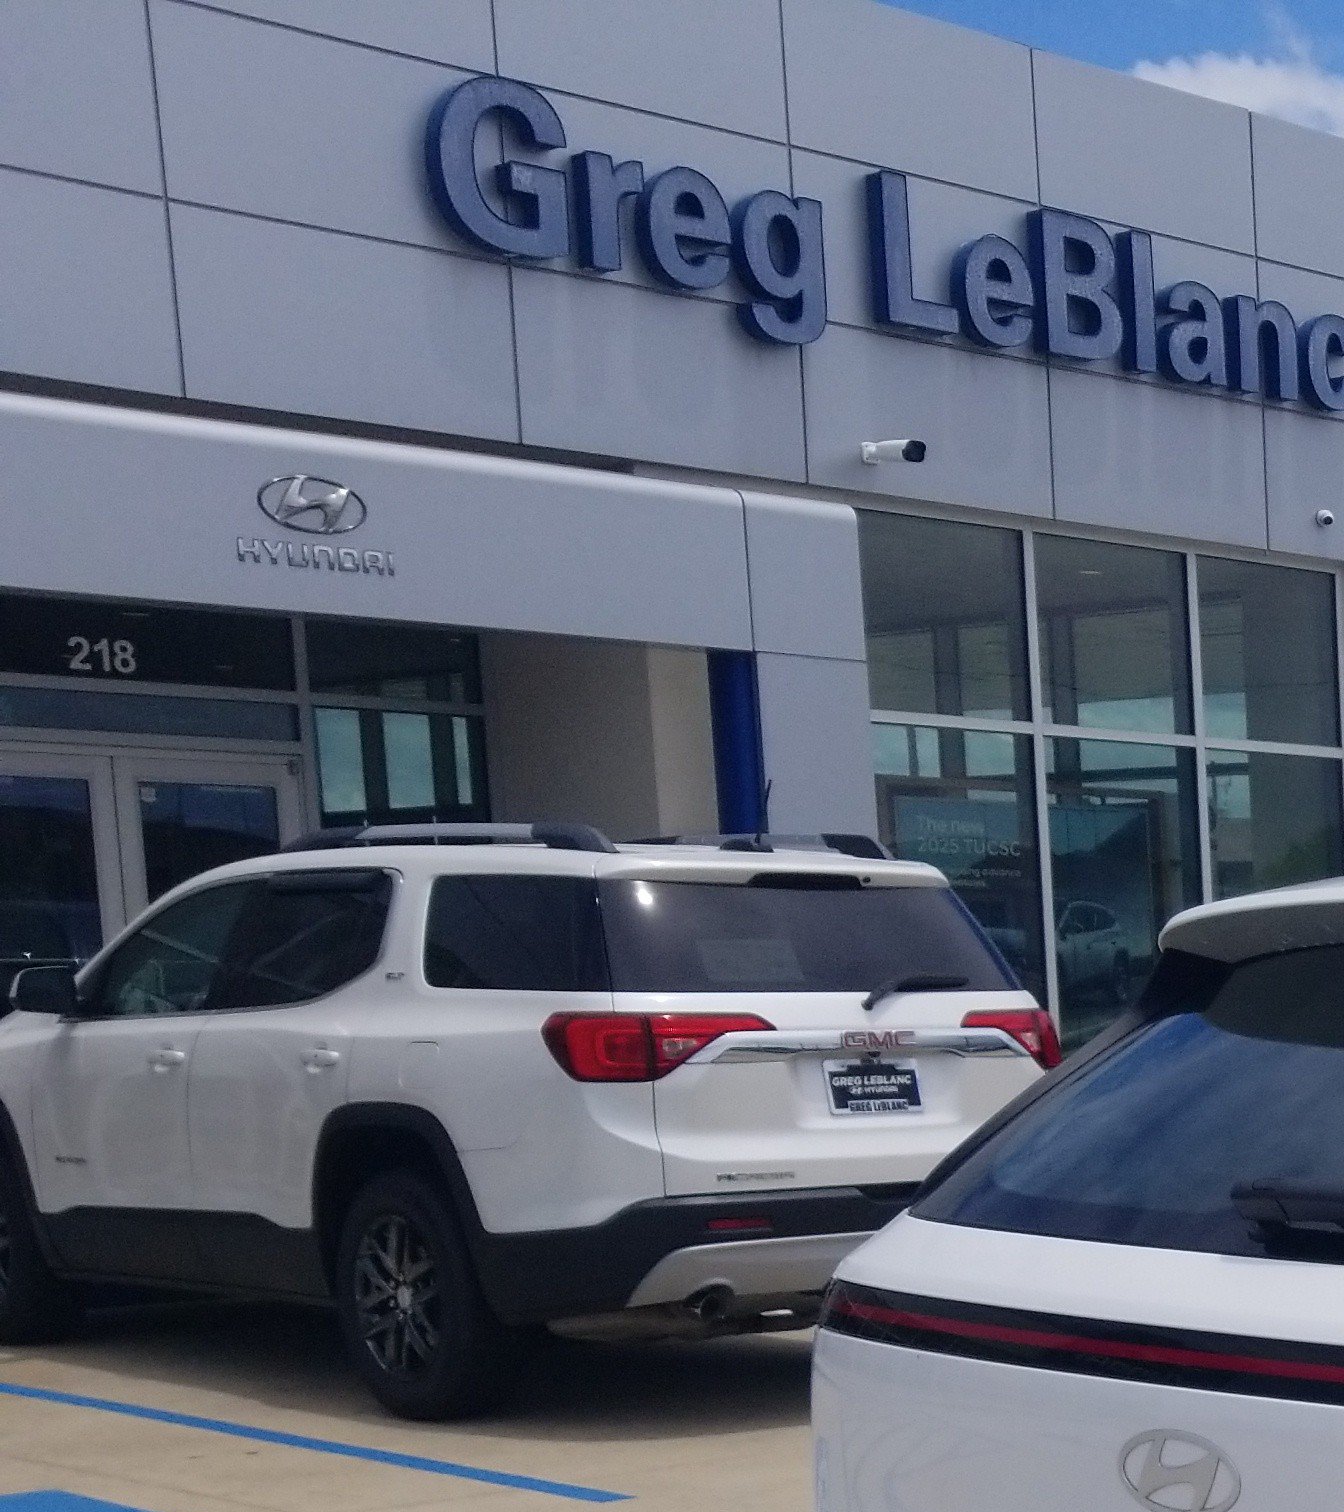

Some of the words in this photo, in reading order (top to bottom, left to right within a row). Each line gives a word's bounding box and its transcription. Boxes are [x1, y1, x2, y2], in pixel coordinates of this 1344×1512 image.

[426, 75, 828, 345] Greg
[236, 536, 396, 577] HYUNDAI
[67, 636, 136, 674] 218
[843, 1030, 916, 1049] GMC
[832, 1076, 863, 1087] GREG
[864, 1074, 911, 1086] LEBLANC
